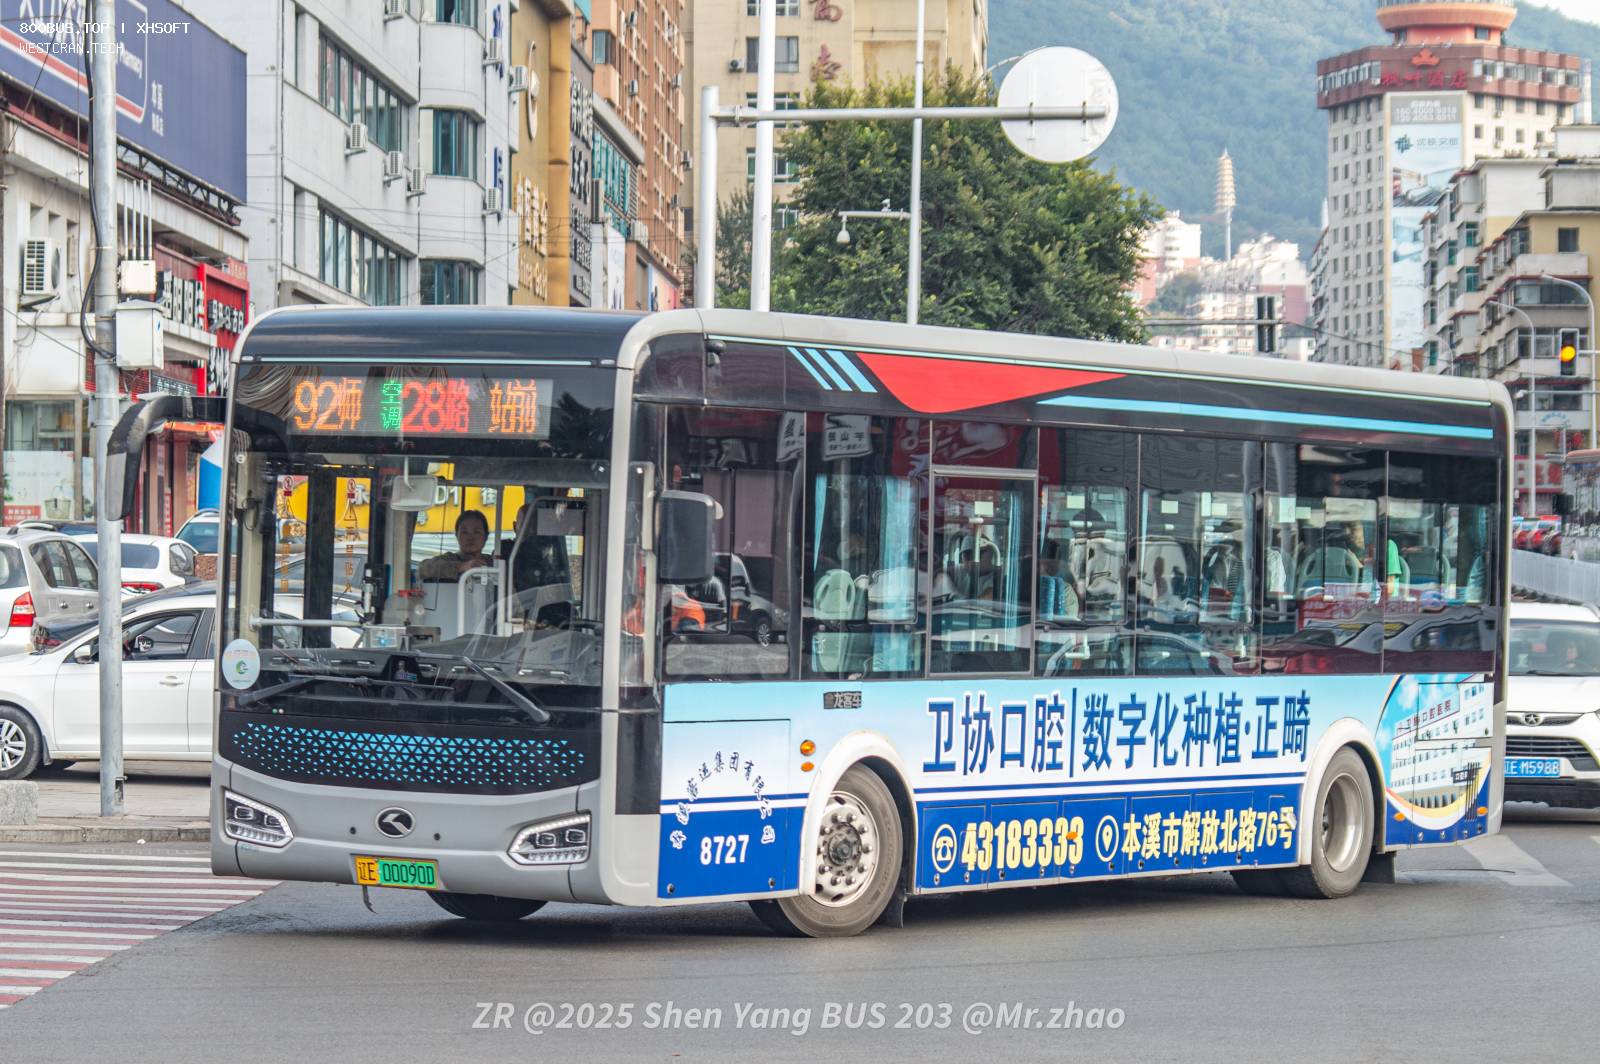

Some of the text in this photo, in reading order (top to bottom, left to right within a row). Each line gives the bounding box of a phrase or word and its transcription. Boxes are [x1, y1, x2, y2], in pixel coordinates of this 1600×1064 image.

[380, 379, 402, 430] 空调
[401, 379, 470, 433] 28路
[488, 379, 536, 432] 站前
[700, 834, 750, 865] 8727
[961, 805, 1297, 872] 43183333 本溪市解放北路76号
